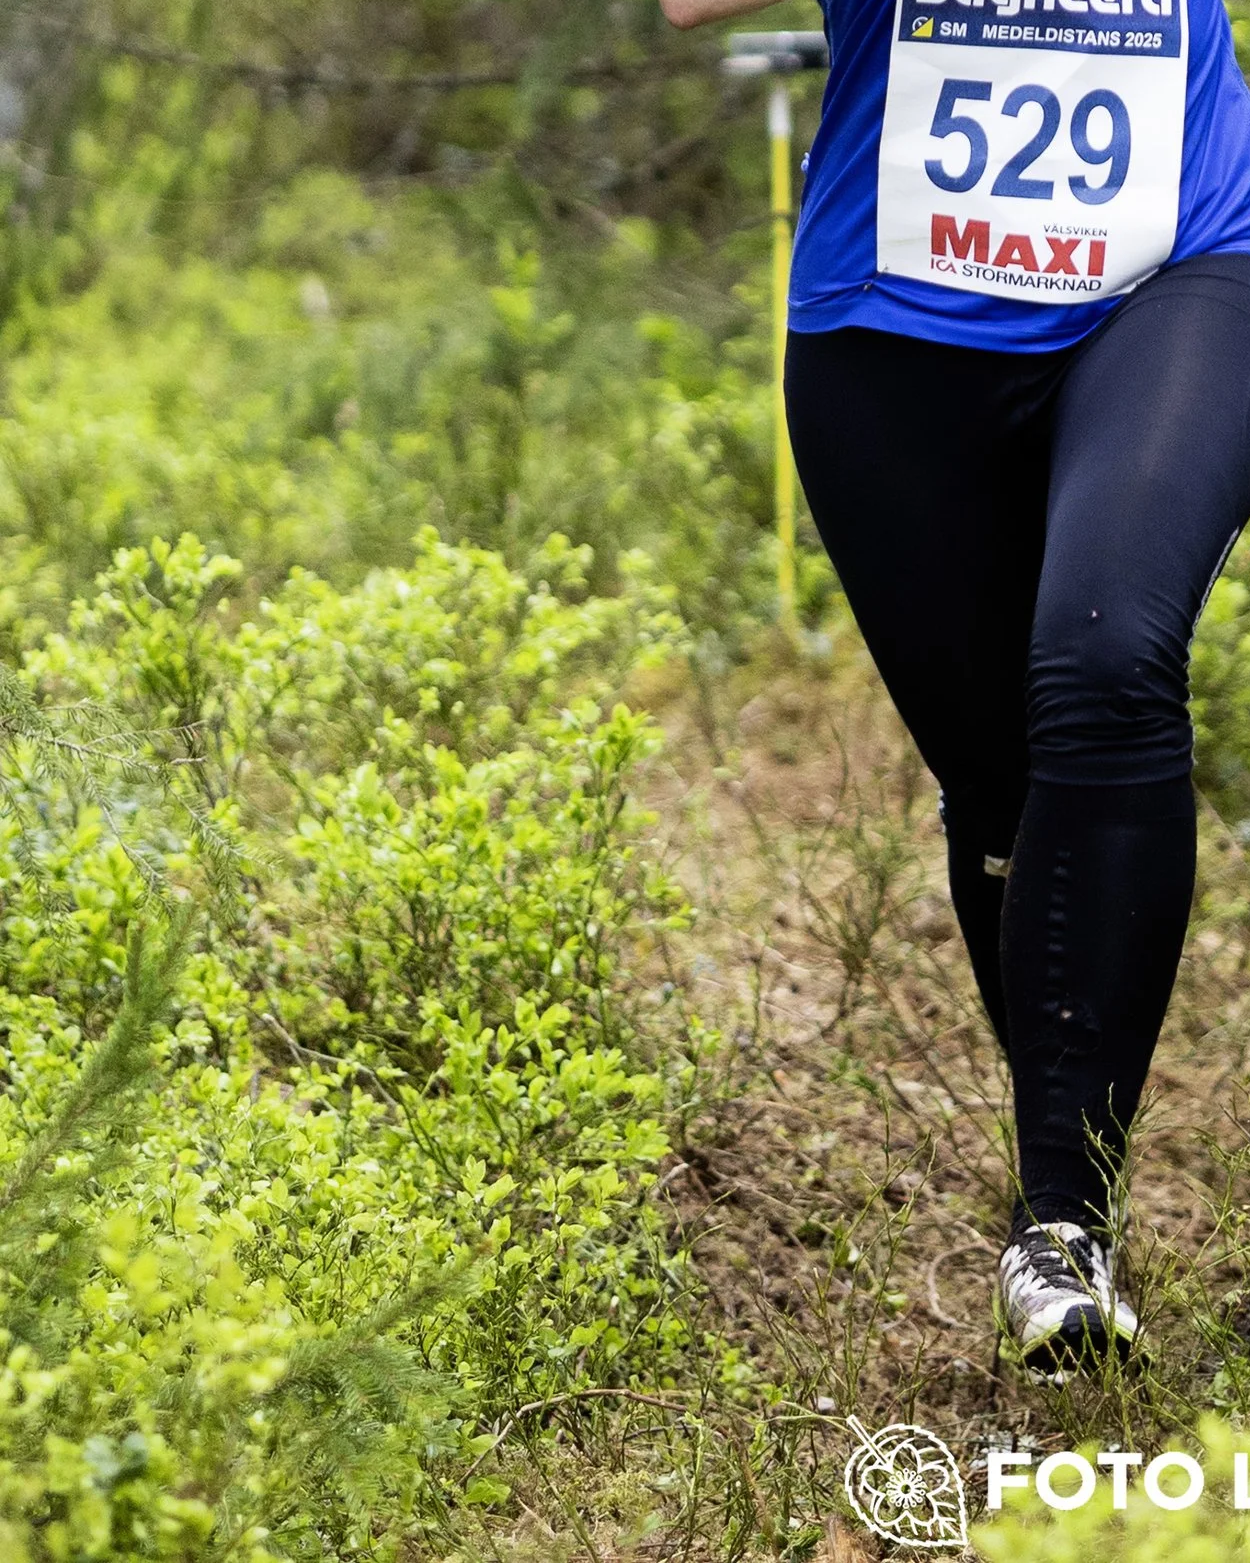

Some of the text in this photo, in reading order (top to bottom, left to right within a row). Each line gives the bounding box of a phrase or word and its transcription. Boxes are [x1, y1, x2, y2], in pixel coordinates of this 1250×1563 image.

[939, 21, 1162, 48] SM MEDELDISTANS 2025
[924, 78, 1132, 206] 529
[930, 213, 1107, 277] MAXI
[930, 258, 1102, 292] ICA STORMARKNAD
